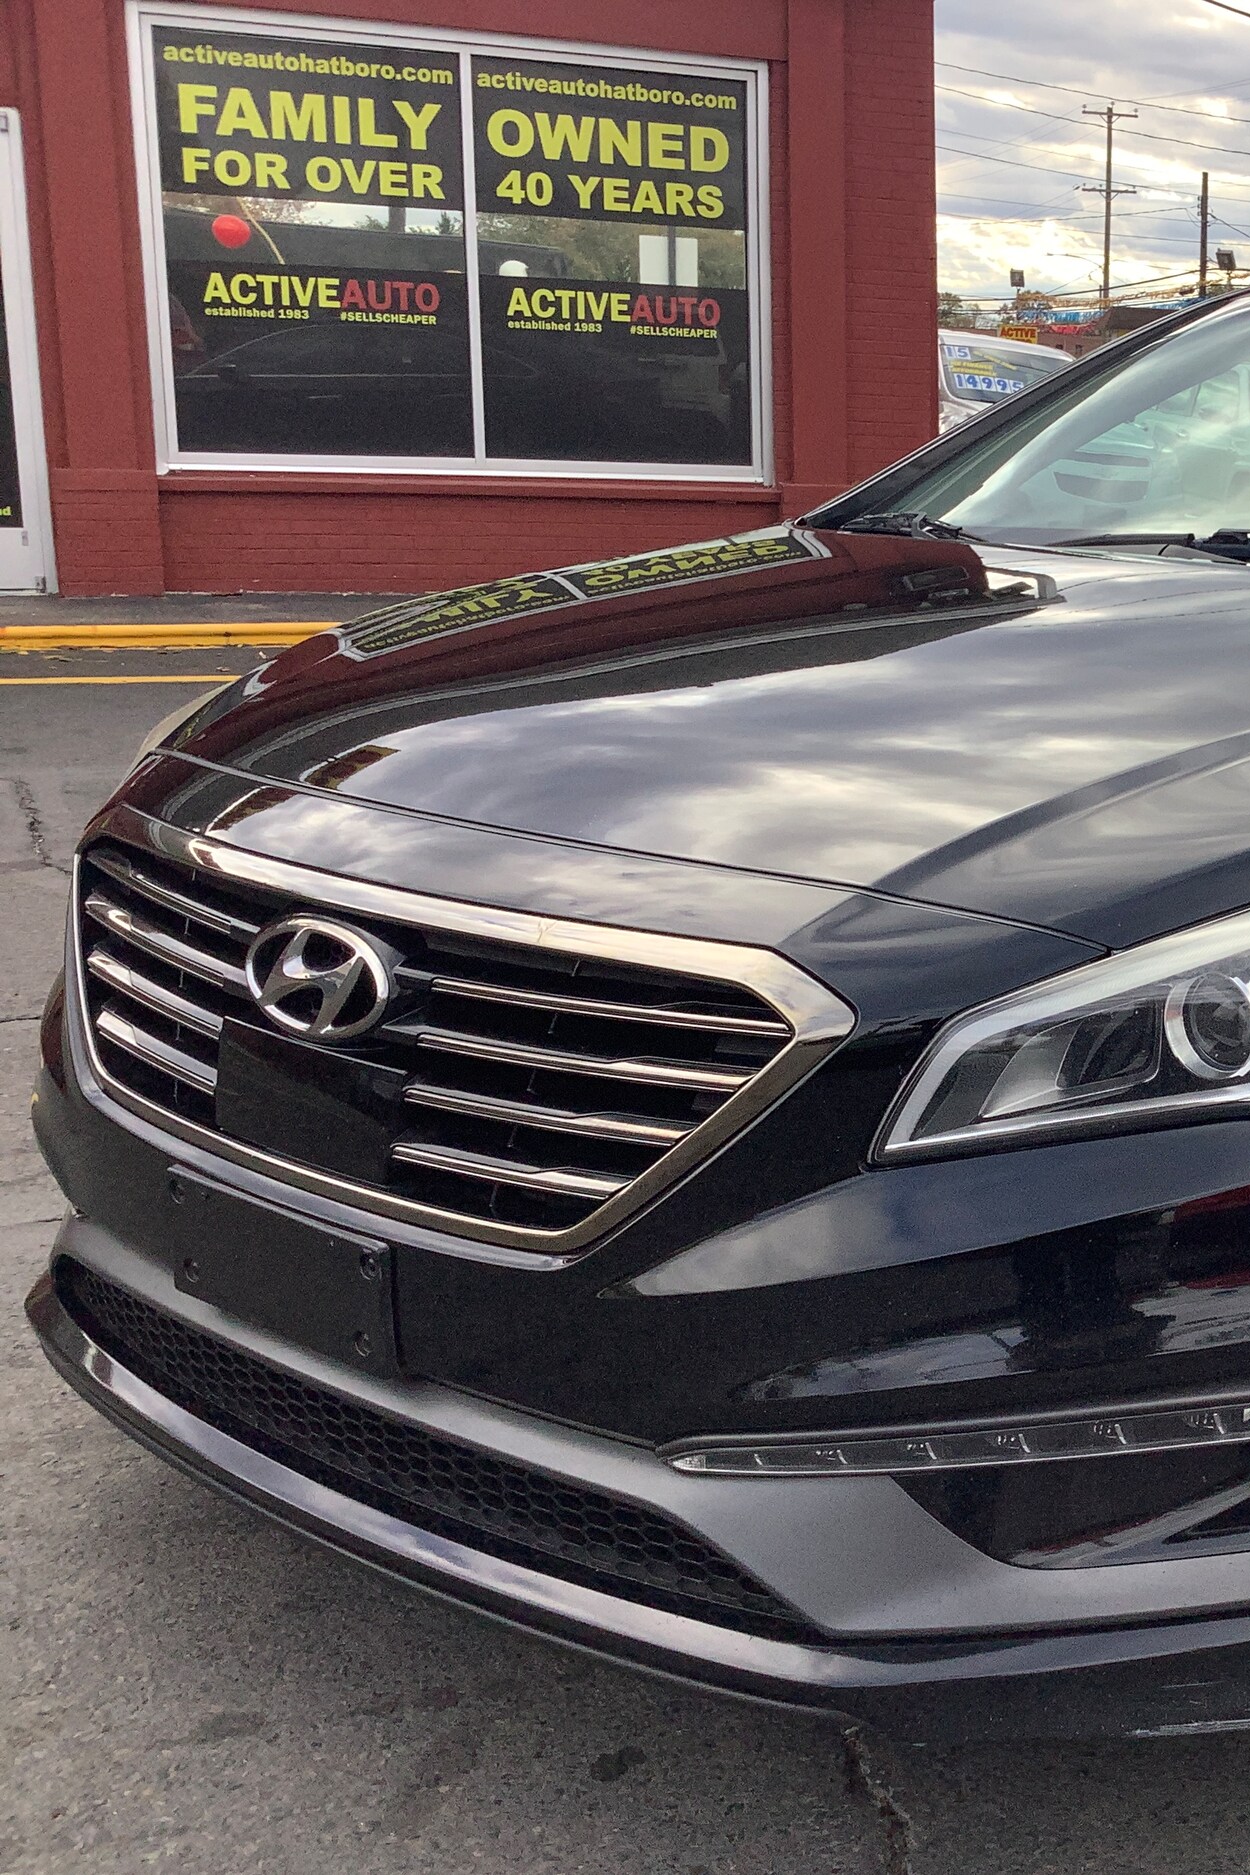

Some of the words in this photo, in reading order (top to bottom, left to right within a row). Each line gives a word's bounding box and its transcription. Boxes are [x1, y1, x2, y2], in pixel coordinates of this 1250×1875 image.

[163, 44, 453, 84] activeautohatboro.com
[476, 72, 737, 110] activeautohatboro.com
[177, 83, 442, 150] FAMILY
[487, 108, 730, 173] OWNED
[181, 147, 291, 189] FOR
[305, 156, 446, 200] OVER
[496, 170, 554, 207] 40
[567, 174, 725, 219] YEARS
[204, 306, 275, 319] established
[278, 308, 310, 320] 1983
[340, 311, 437, 325] #SELLSCHEAPER
[508, 319, 571, 332] established
[574, 321, 602, 333] 1983
[630, 325, 717, 339] #SELLSCHEAPER
[1000, 326, 1036, 338] ACTIVE
[945, 347, 969, 358] 15
[956, 375, 1023, 392] 14995
